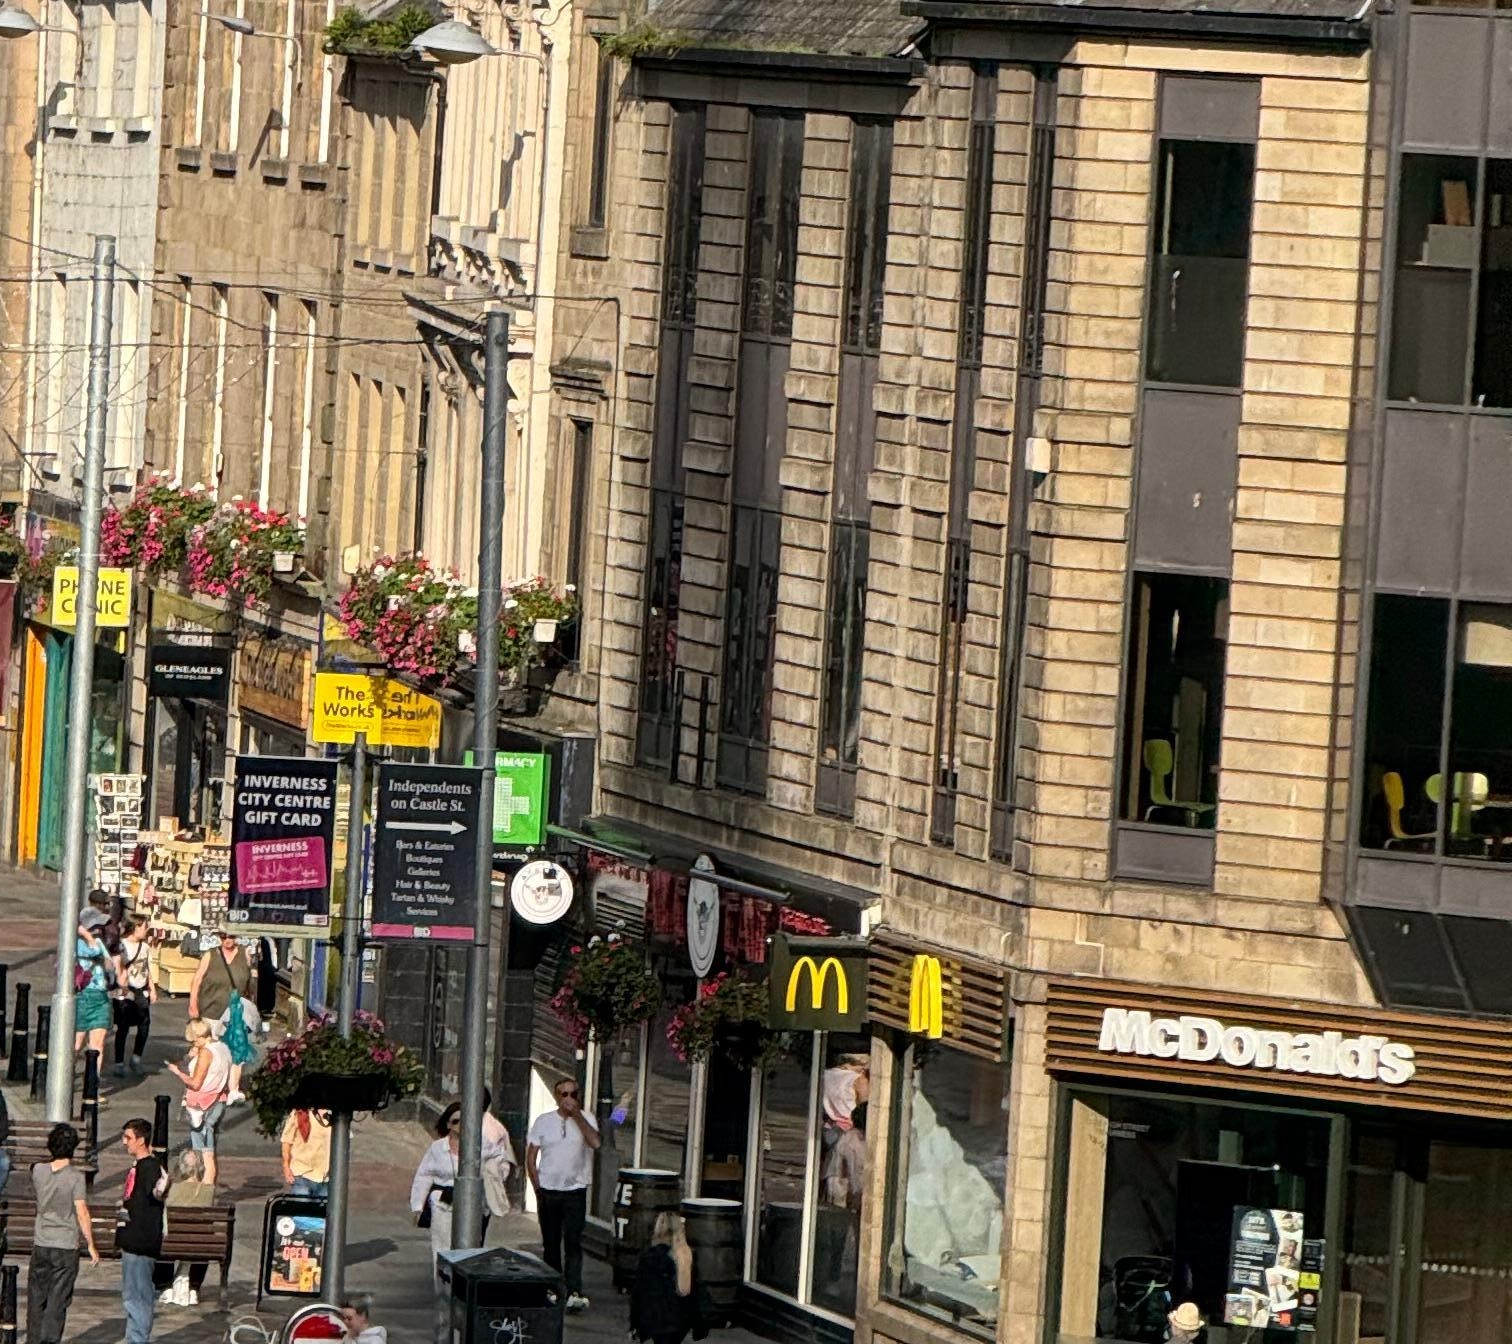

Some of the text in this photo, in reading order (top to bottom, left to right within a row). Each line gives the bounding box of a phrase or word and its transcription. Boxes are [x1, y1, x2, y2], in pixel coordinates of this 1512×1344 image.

[59, 578, 125, 596] PHNE
[154, 664, 224, 676] GLENEAGLES
[336, 686, 366, 701] The
[323, 702, 375, 719] Works
[495, 757, 537, 768] RMACY
[244, 774, 328, 791] INVERNESS
[388, 778, 472, 796] Independents
[237, 792, 331, 810] CITY CENTRE
[390, 797, 466, 812] on Castle St.
[244, 811, 322, 827] GIFT CARD
[252, 841, 309, 855] INVERNESS
[395, 879, 451, 892] Hair & Beauty
[417, 893, 425, 903] &
[1098, 1007, 1416, 1085] McDonald's
